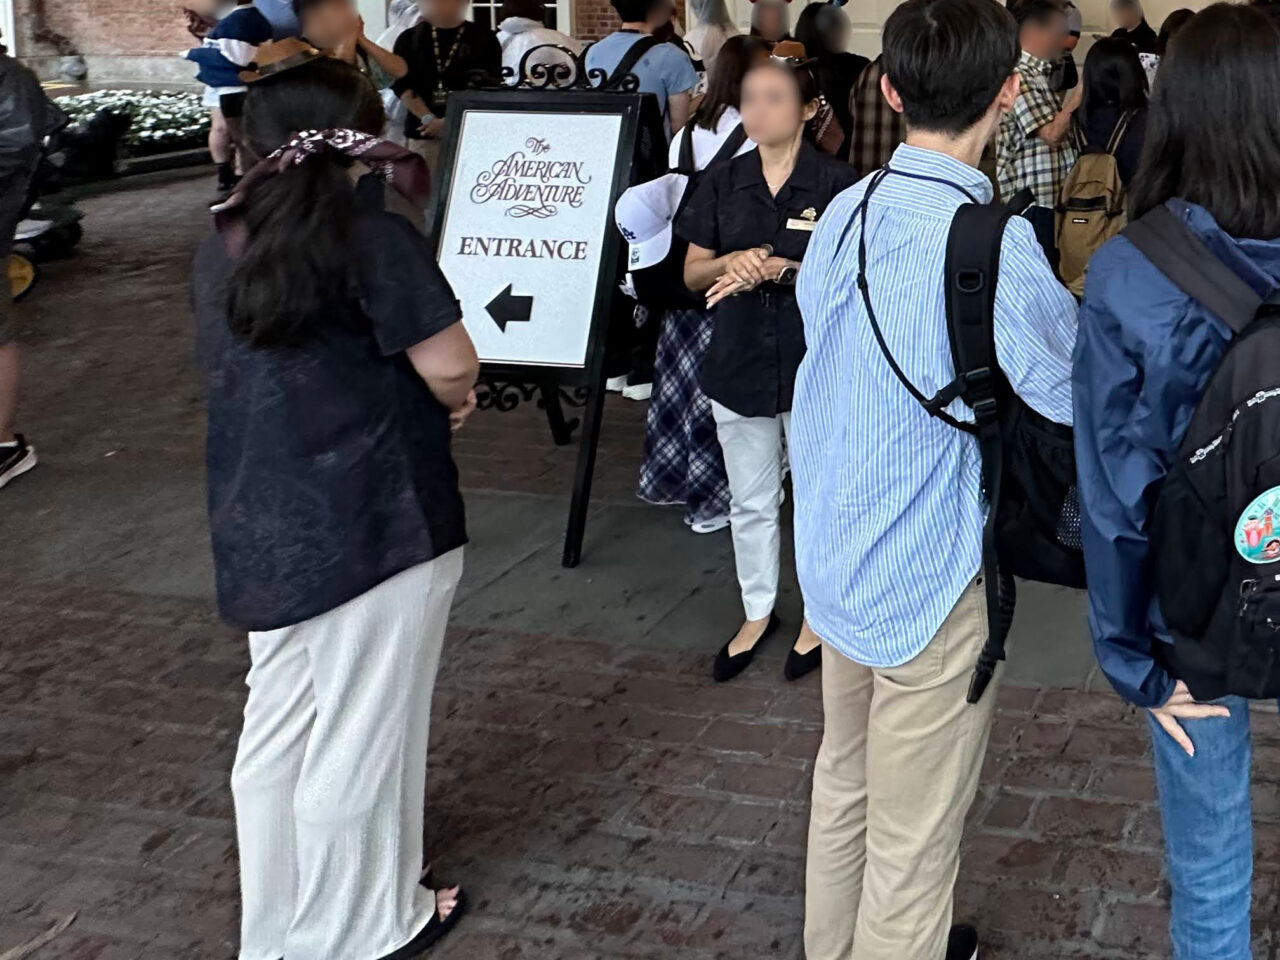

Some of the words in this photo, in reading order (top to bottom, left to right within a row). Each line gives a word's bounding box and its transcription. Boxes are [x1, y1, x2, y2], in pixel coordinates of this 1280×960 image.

[525, 137, 551, 155] The
[477, 151, 592, 184] AMERICAN
[470, 178, 586, 210] ADVENTURE
[457, 236, 588, 260] ENTRANCE
